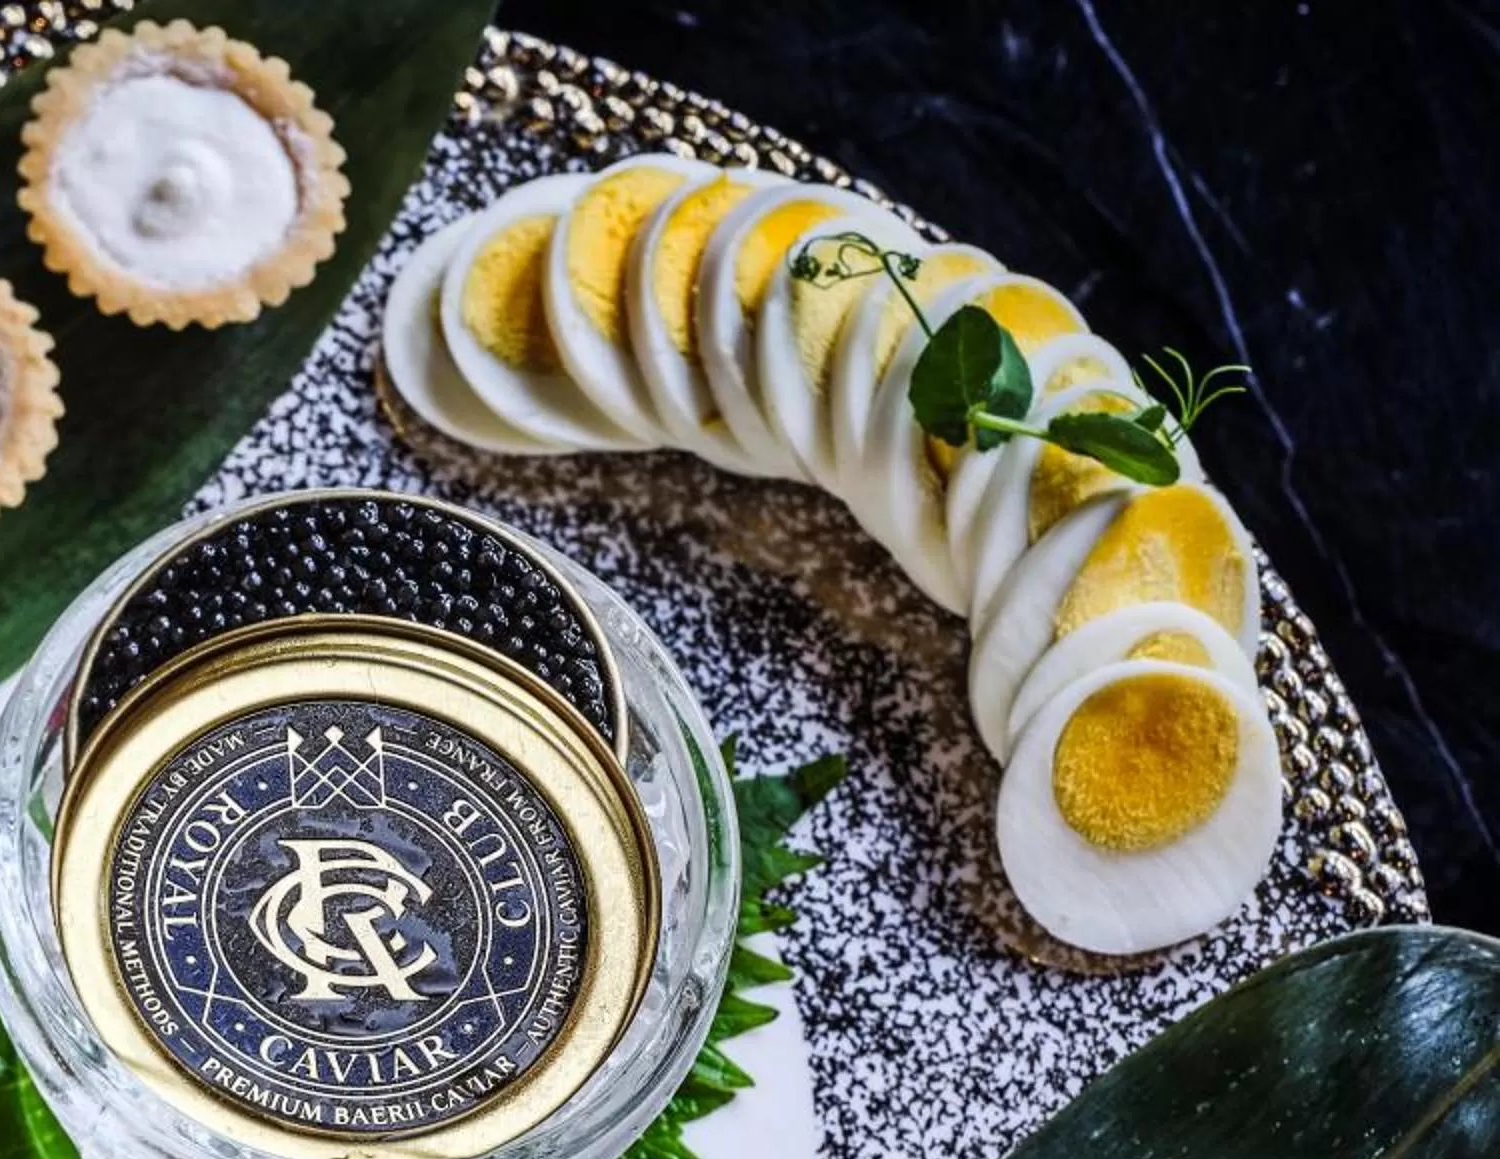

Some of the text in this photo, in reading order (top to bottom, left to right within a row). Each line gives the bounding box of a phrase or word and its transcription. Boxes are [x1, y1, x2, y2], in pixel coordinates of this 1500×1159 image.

[117, 730, 246, 1036] MADE BY TRADITIONAL METHODS
[162, 789, 530, 1086] ROYAL CAVIAR CLUB
[425, 731, 579, 1045] AUTHENTIC CAVIAR FROM FRANCE
[201, 1056, 516, 1126] PREMIUM BAERII CAVIAR
